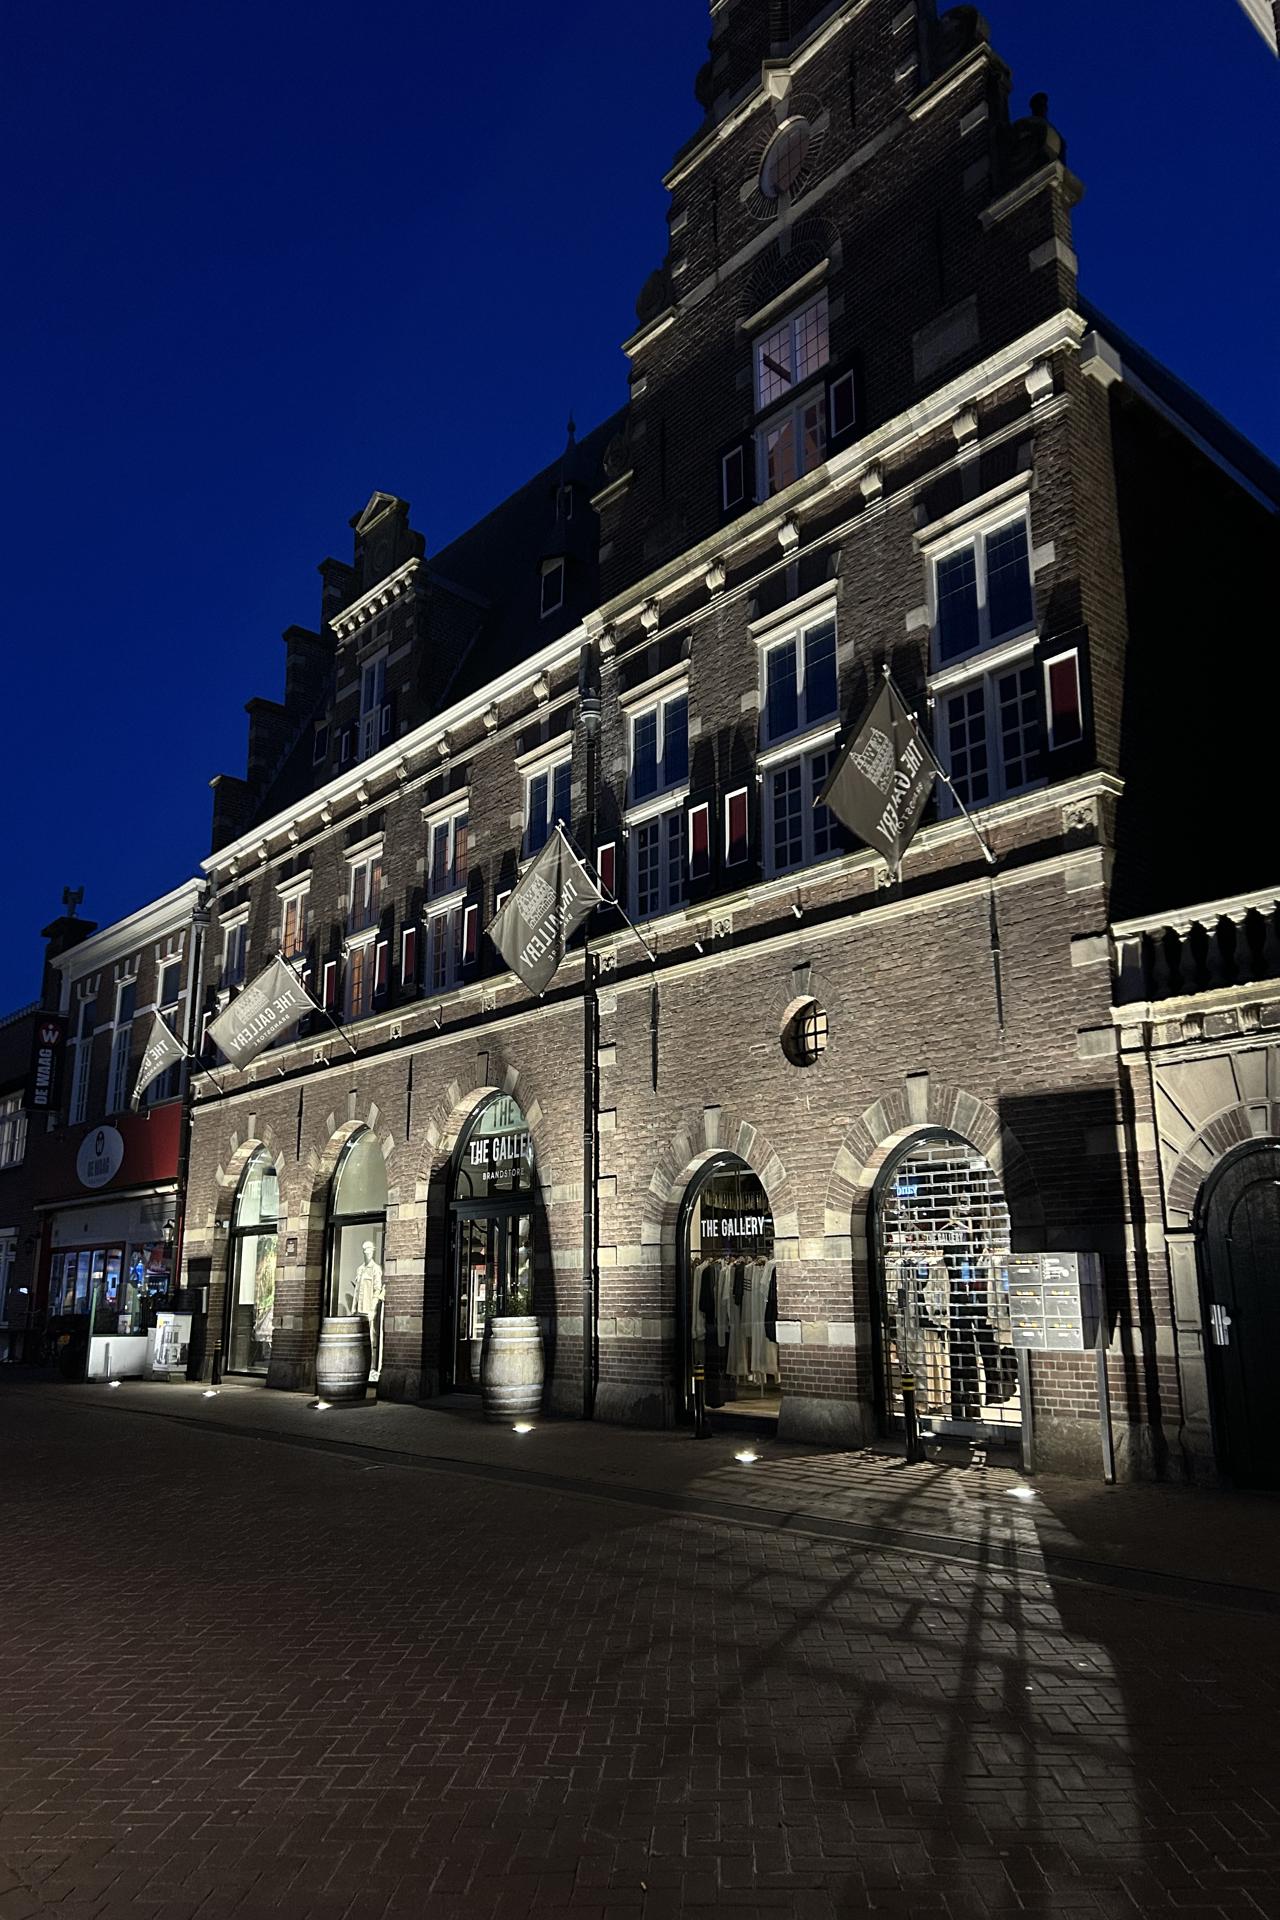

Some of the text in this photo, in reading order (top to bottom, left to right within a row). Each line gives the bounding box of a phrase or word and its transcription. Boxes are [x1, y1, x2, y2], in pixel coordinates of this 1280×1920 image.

[34, 1048, 53, 1105] DE WAAG
[469, 1139, 489, 1165] THE
[482, 1167, 524, 1181] BRANDSTORE
[701, 1216, 765, 1237] THE GALLERY
